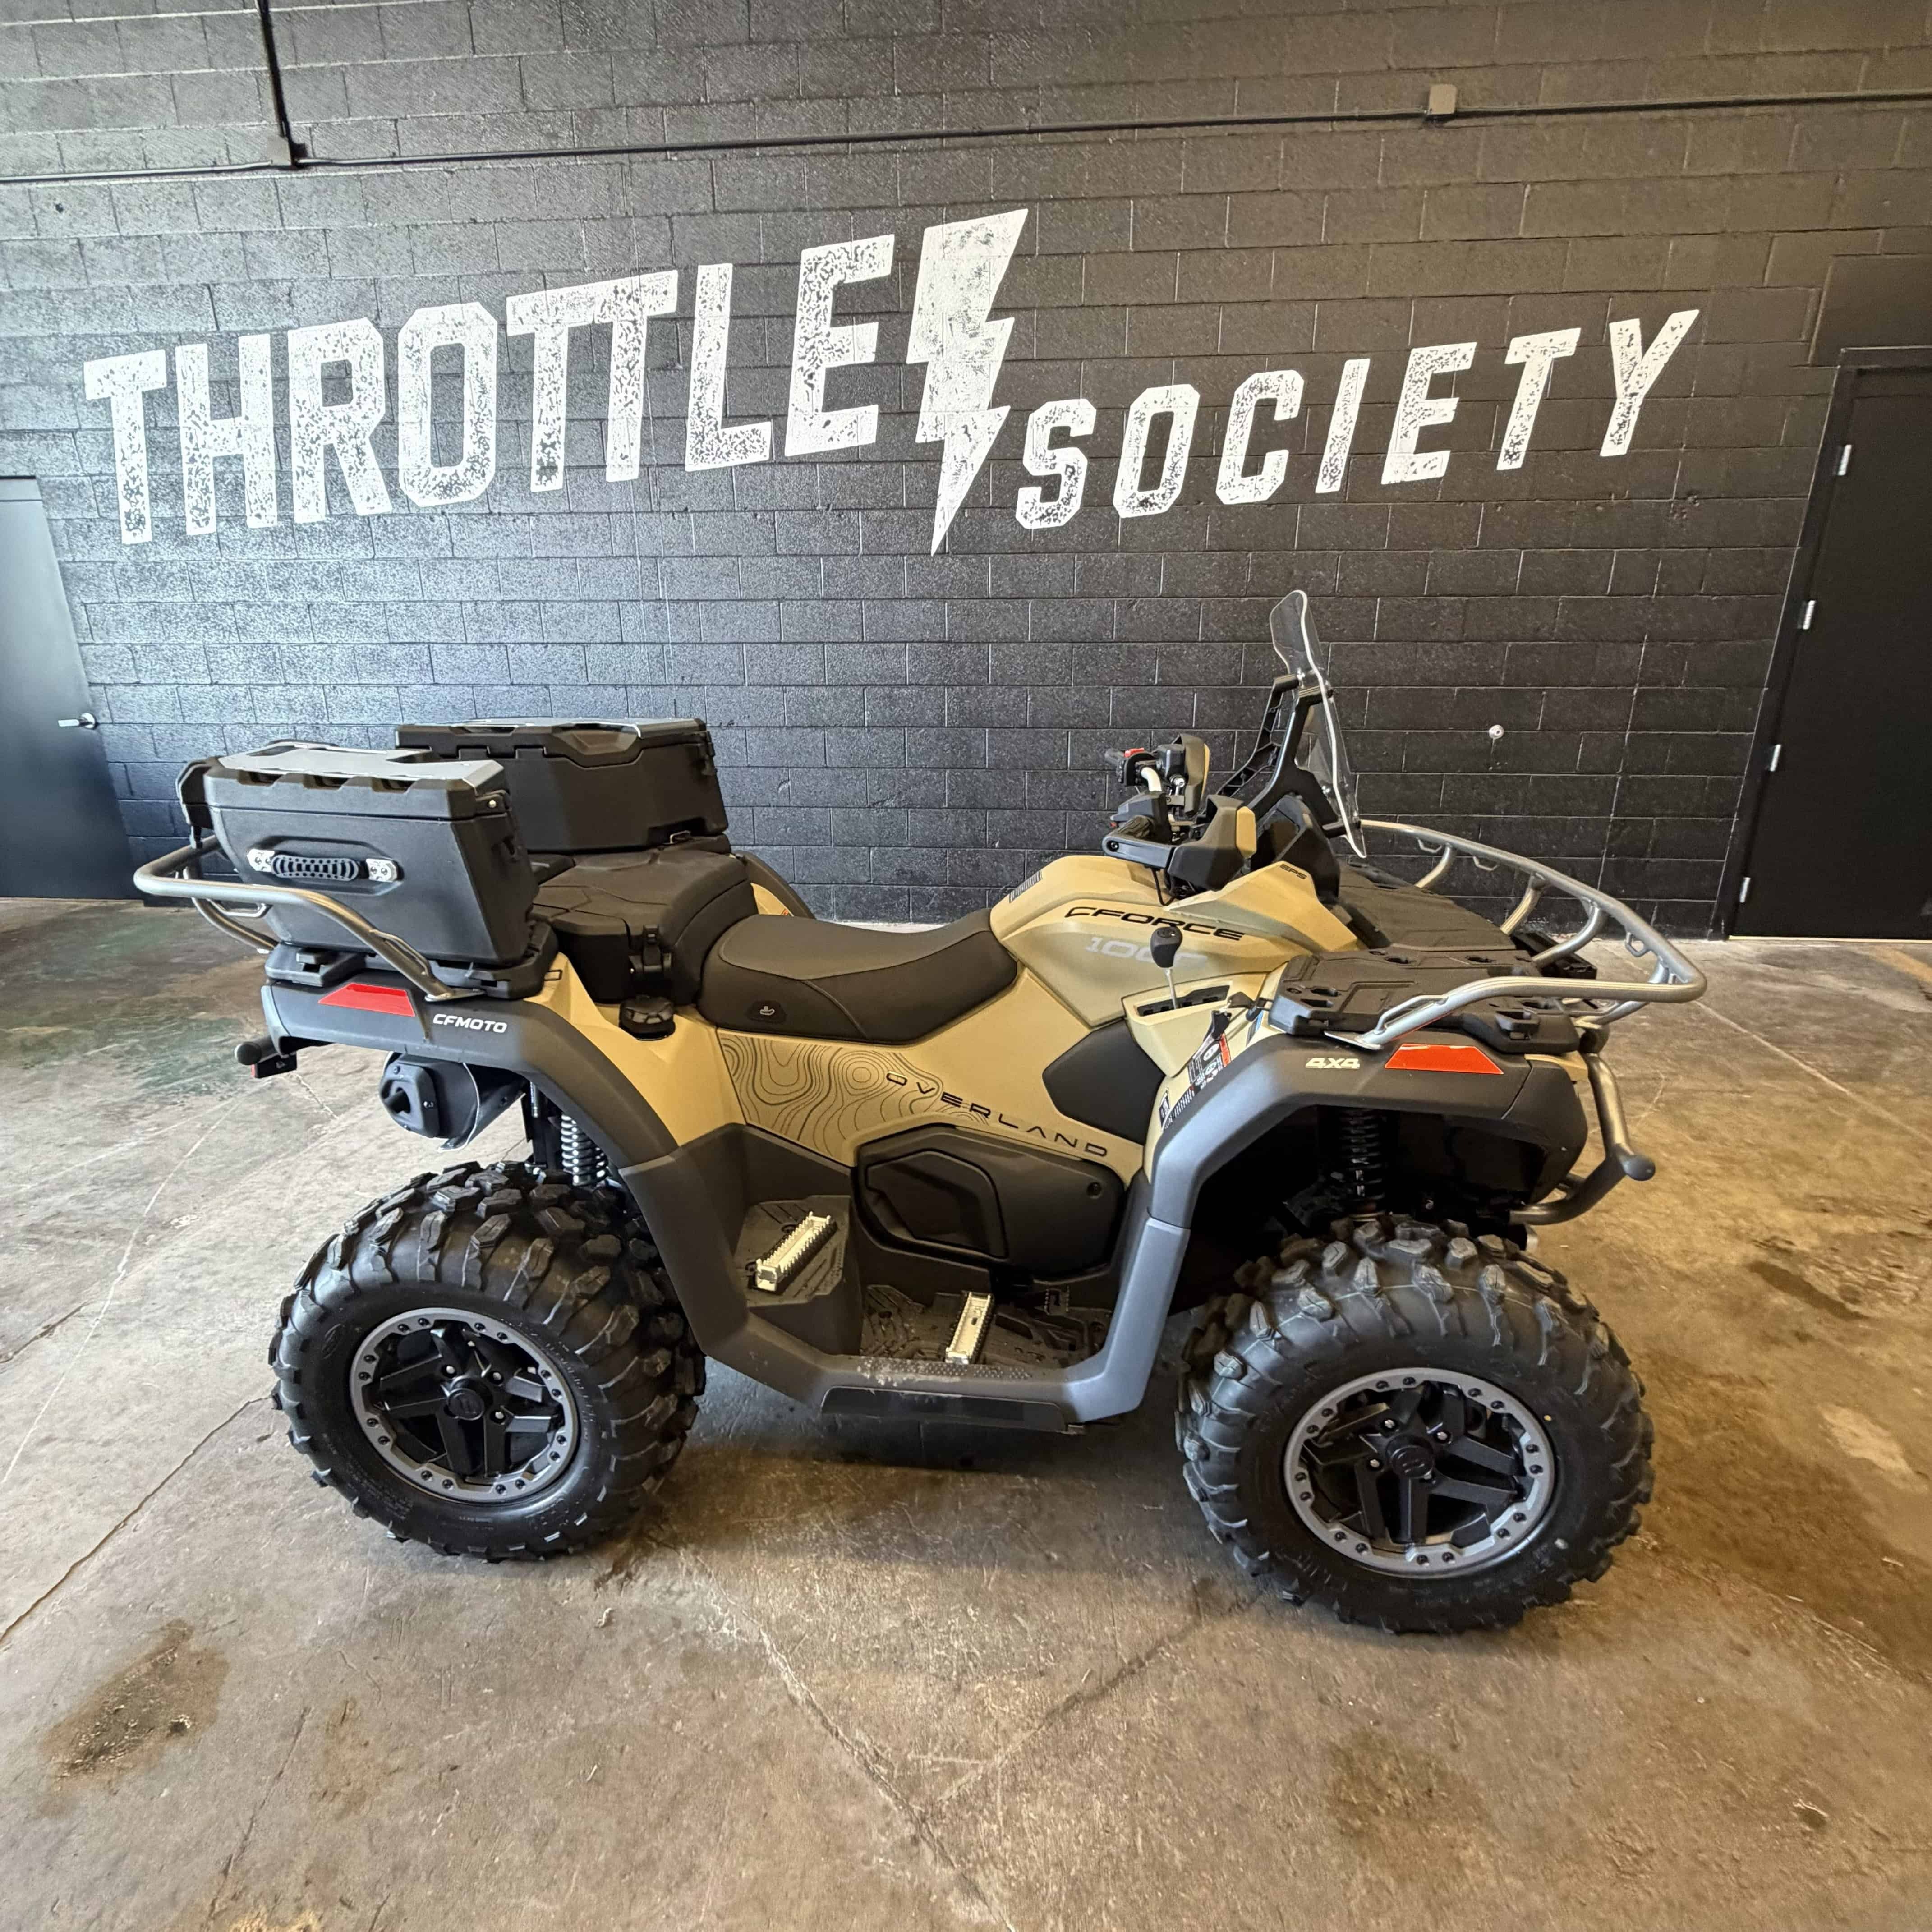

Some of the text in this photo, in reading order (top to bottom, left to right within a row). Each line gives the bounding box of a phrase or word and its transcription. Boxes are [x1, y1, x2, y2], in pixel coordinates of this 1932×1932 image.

[83, 234, 1699, 544] THROTTLE SOCIETY
[1280, 864, 1307, 879] EPS
[1065, 906, 1246, 941] CFORCE
[432, 1013, 508, 1033] CFMOTO
[886, 1071, 1107, 1157] OVERLAND
